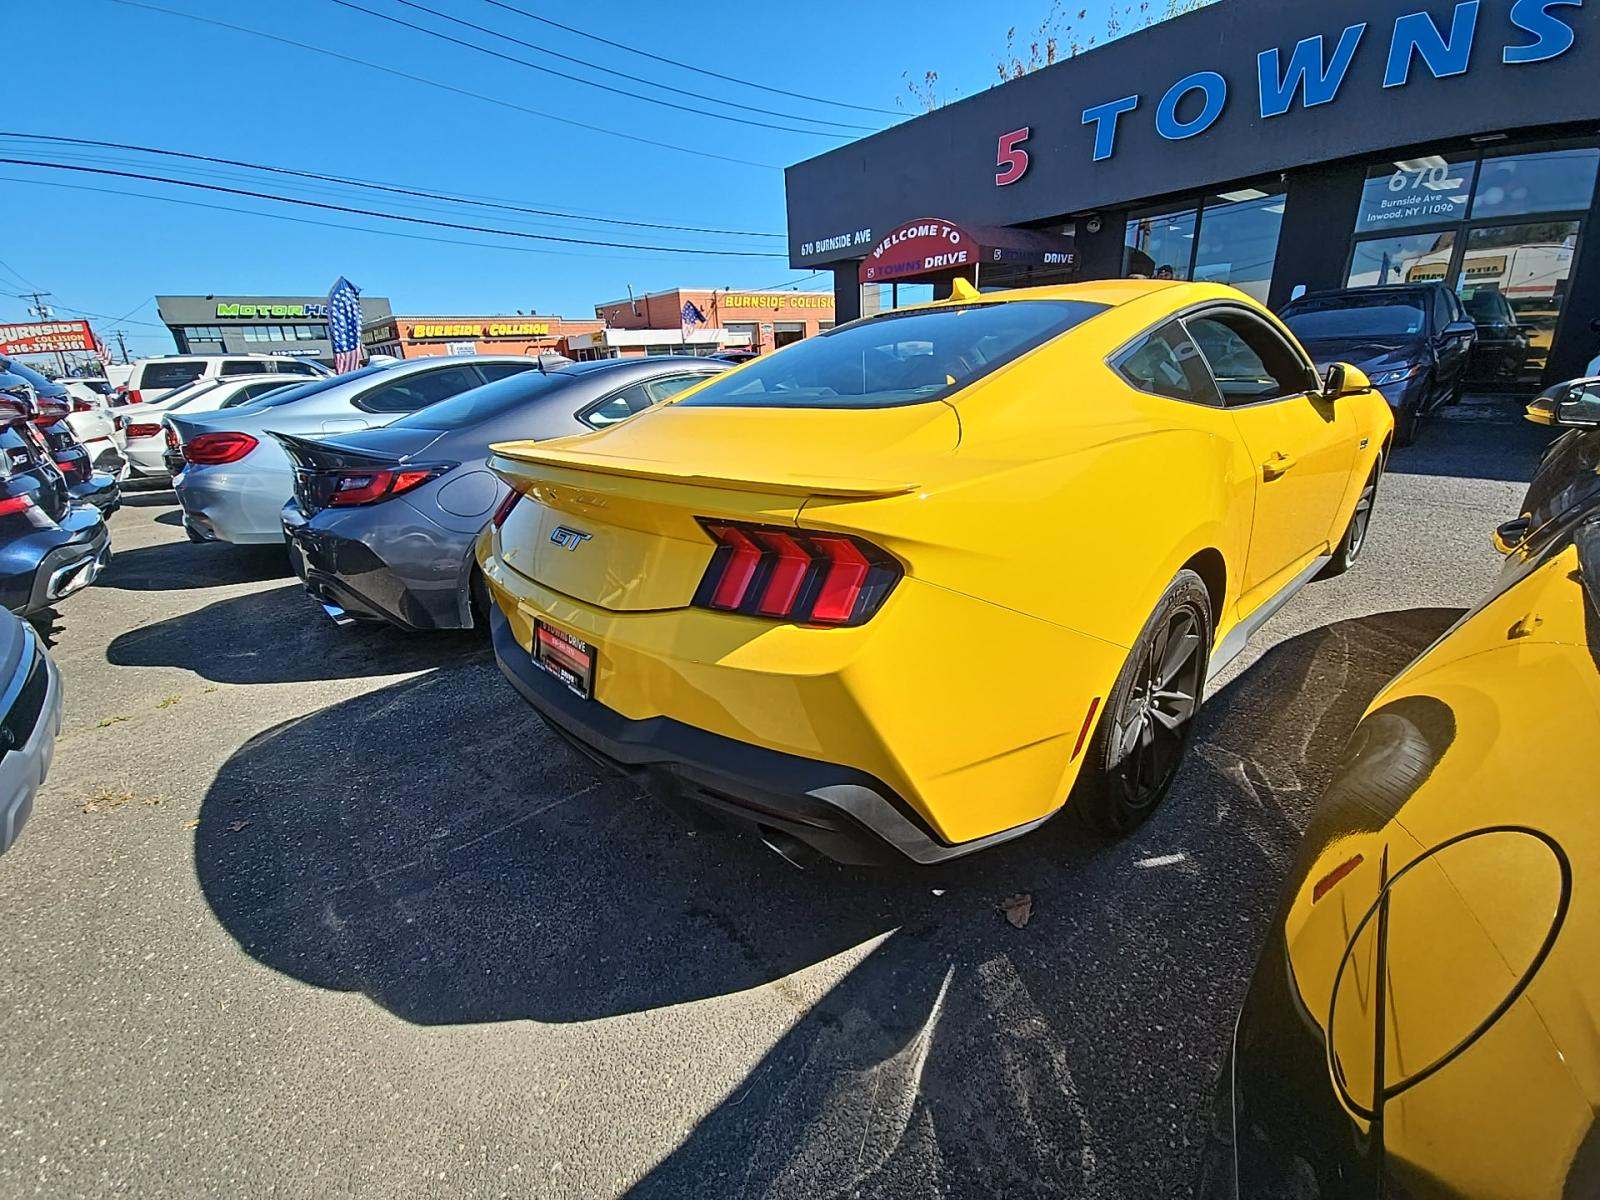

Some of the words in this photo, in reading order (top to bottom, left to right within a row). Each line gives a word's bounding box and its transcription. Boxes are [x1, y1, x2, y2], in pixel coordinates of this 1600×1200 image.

[995, 126, 1031, 187] 5
[1080, 0, 1584, 161] TOWNS
[1388, 165, 1448, 192] 670
[1380, 195, 1421, 208] Burnside
[1422, 194, 1442, 203] Ave
[1367, 209, 1403, 222] Inwood,
[1405, 207, 1420, 217] NY
[1422, 203, 1454, 215] 11096
[801, 242, 814, 256] 670
[815, 233, 851, 253] BURNSIDE
[854, 228, 871, 245] AVE
[873, 224, 939, 259] WELCOME
[941, 225, 960, 245] TO
[878, 260, 921, 275] TOWNS
[924, 250, 967, 269] DRIVE
[1044, 253, 1074, 263] DRIVE
[725, 295, 785, 308] BURNSIDE
[35, 334, 85, 343] COLLISION
[413, 325, 481, 337] BURNSIDE
[489, 324, 549, 336] COLLISION
[550, 525, 593, 551] GT
[568, 634, 586, 653] DRIVE
